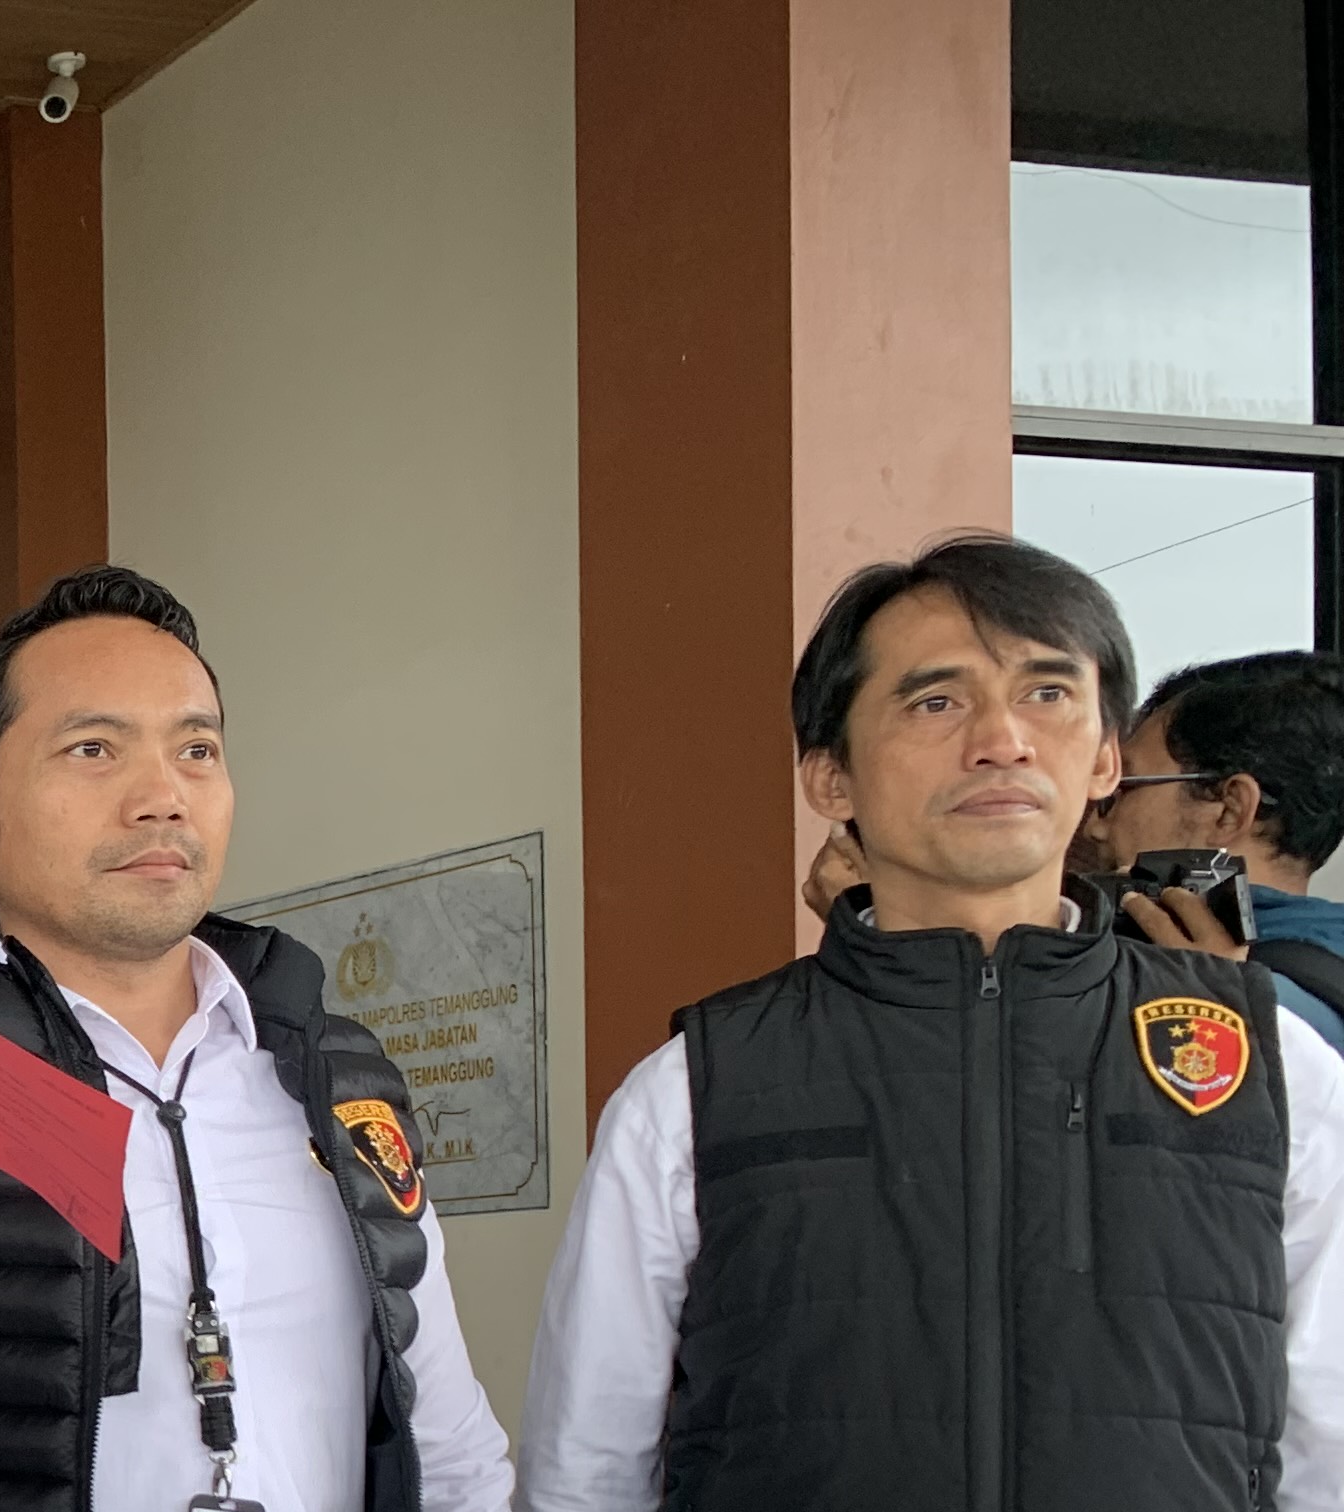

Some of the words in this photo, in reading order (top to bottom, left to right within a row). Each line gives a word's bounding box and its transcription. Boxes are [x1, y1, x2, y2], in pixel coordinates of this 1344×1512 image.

[363, 1001, 426, 1028] MAPOLRES
[430, 984, 518, 1017] TEMANGGUNG
[1147, 1004, 1234, 1025] RESERSE
[386, 1034, 420, 1056] MASA
[423, 1023, 478, 1050] JABATAN
[408, 1057, 494, 1088] TEMANGGUNG
